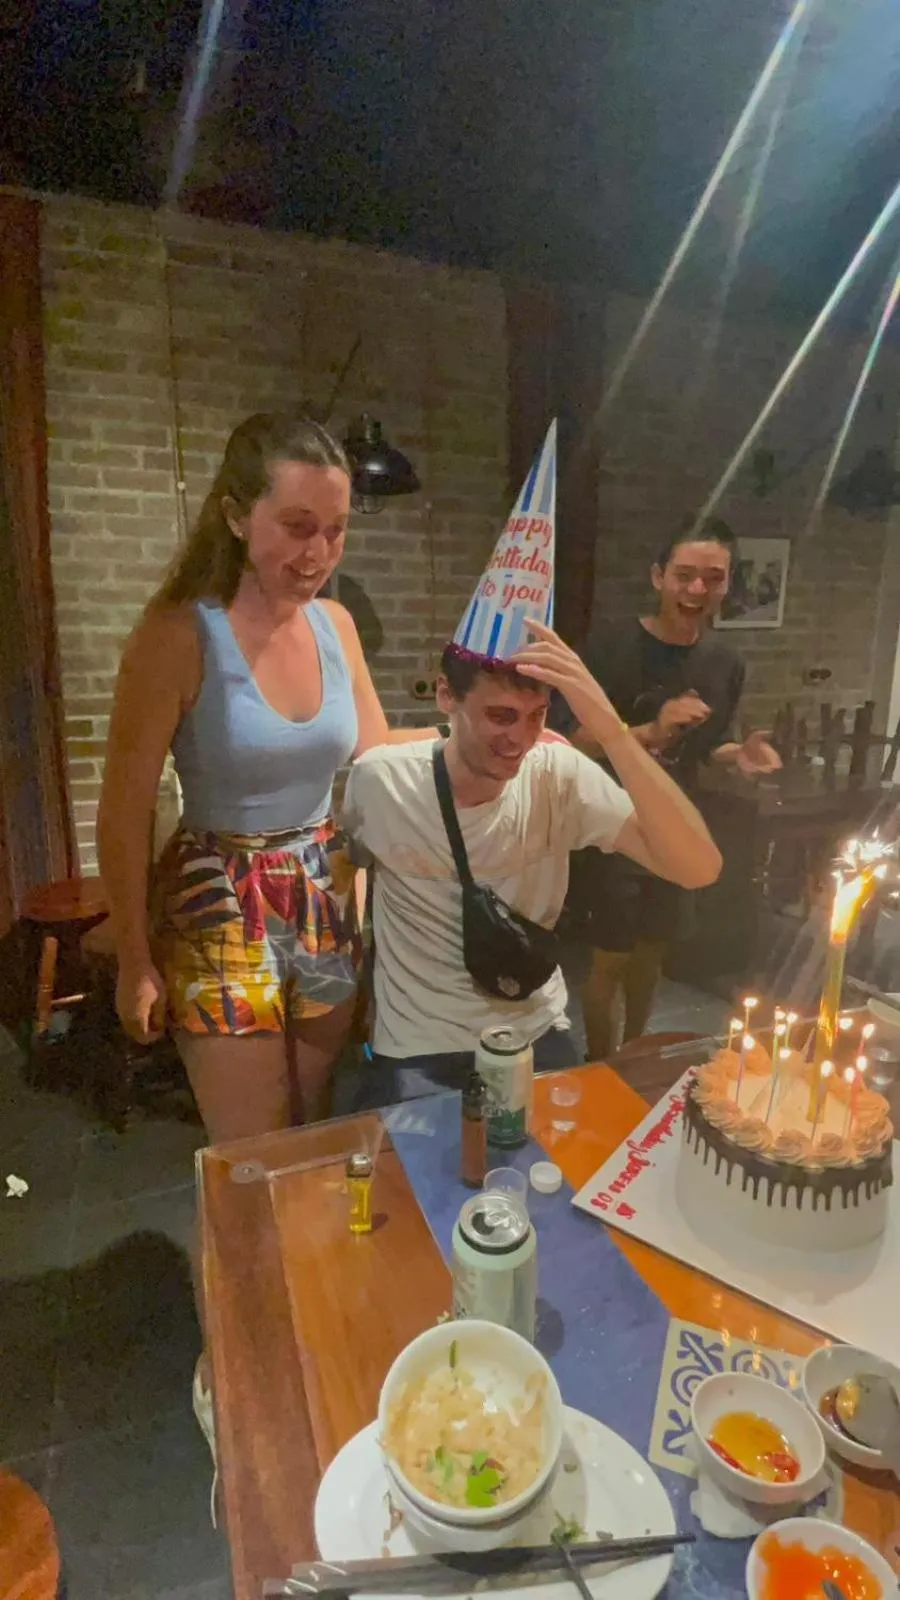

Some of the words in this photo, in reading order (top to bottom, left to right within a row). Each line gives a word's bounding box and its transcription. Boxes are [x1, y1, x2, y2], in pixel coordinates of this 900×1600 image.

[506, 517, 552, 548] appy
[482, 577, 497, 597] to
[502, 584, 543, 608] you
